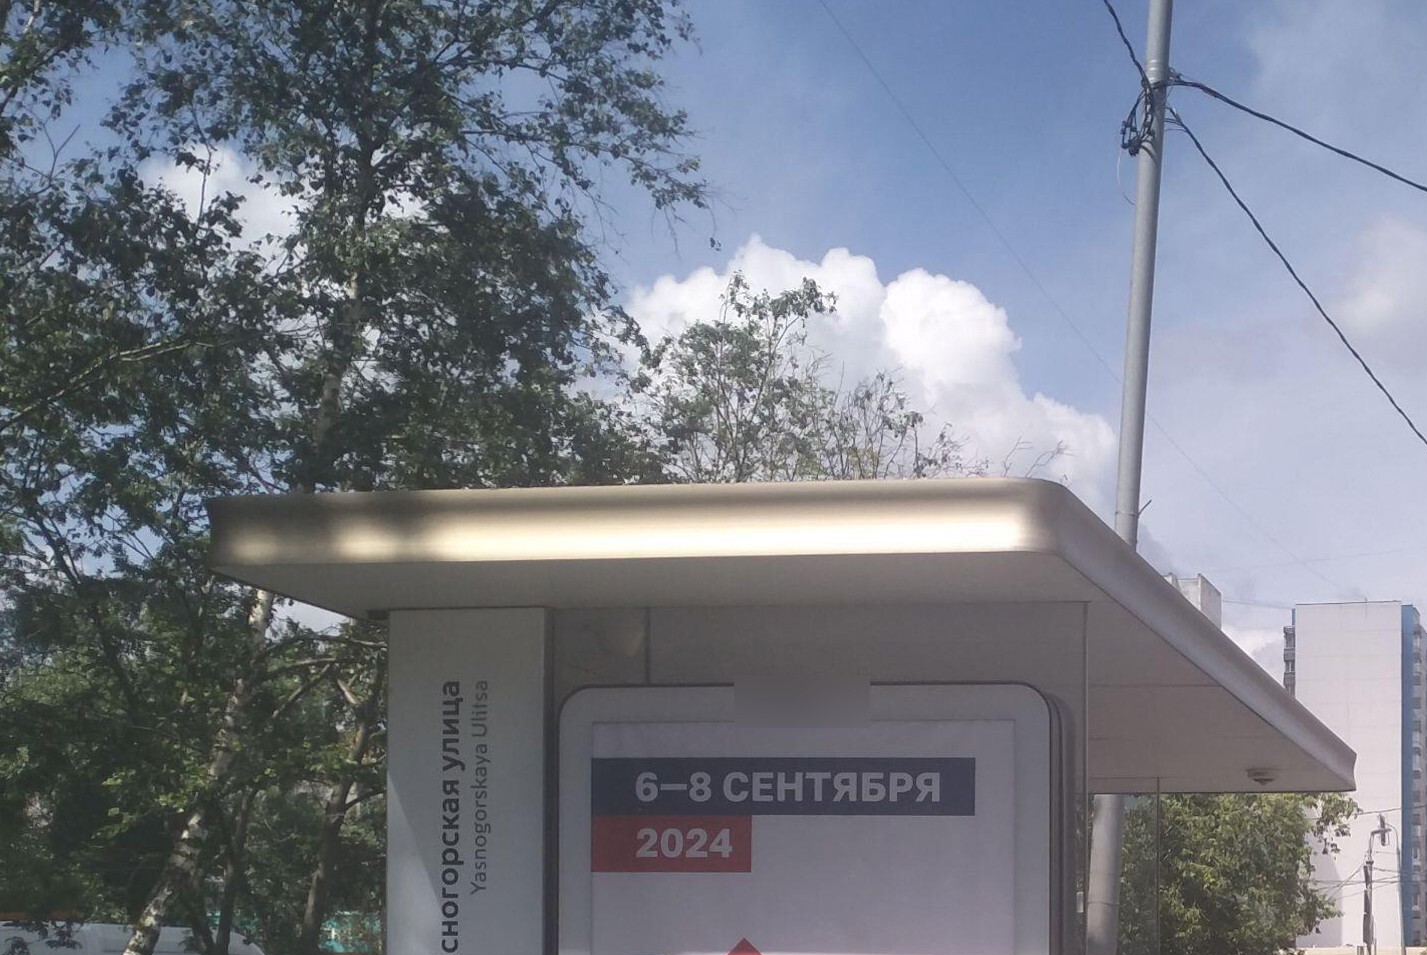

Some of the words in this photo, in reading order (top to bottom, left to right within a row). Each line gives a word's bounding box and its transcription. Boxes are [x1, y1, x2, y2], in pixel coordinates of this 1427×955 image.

[442, 681, 466, 772] улица
[471, 680, 488, 737] Ulitsa
[722, 771, 941, 803] СЕНТЯБРЯ
[470, 743, 491, 895] Yasnogorskaya
[635, 827, 733, 859] 2024
